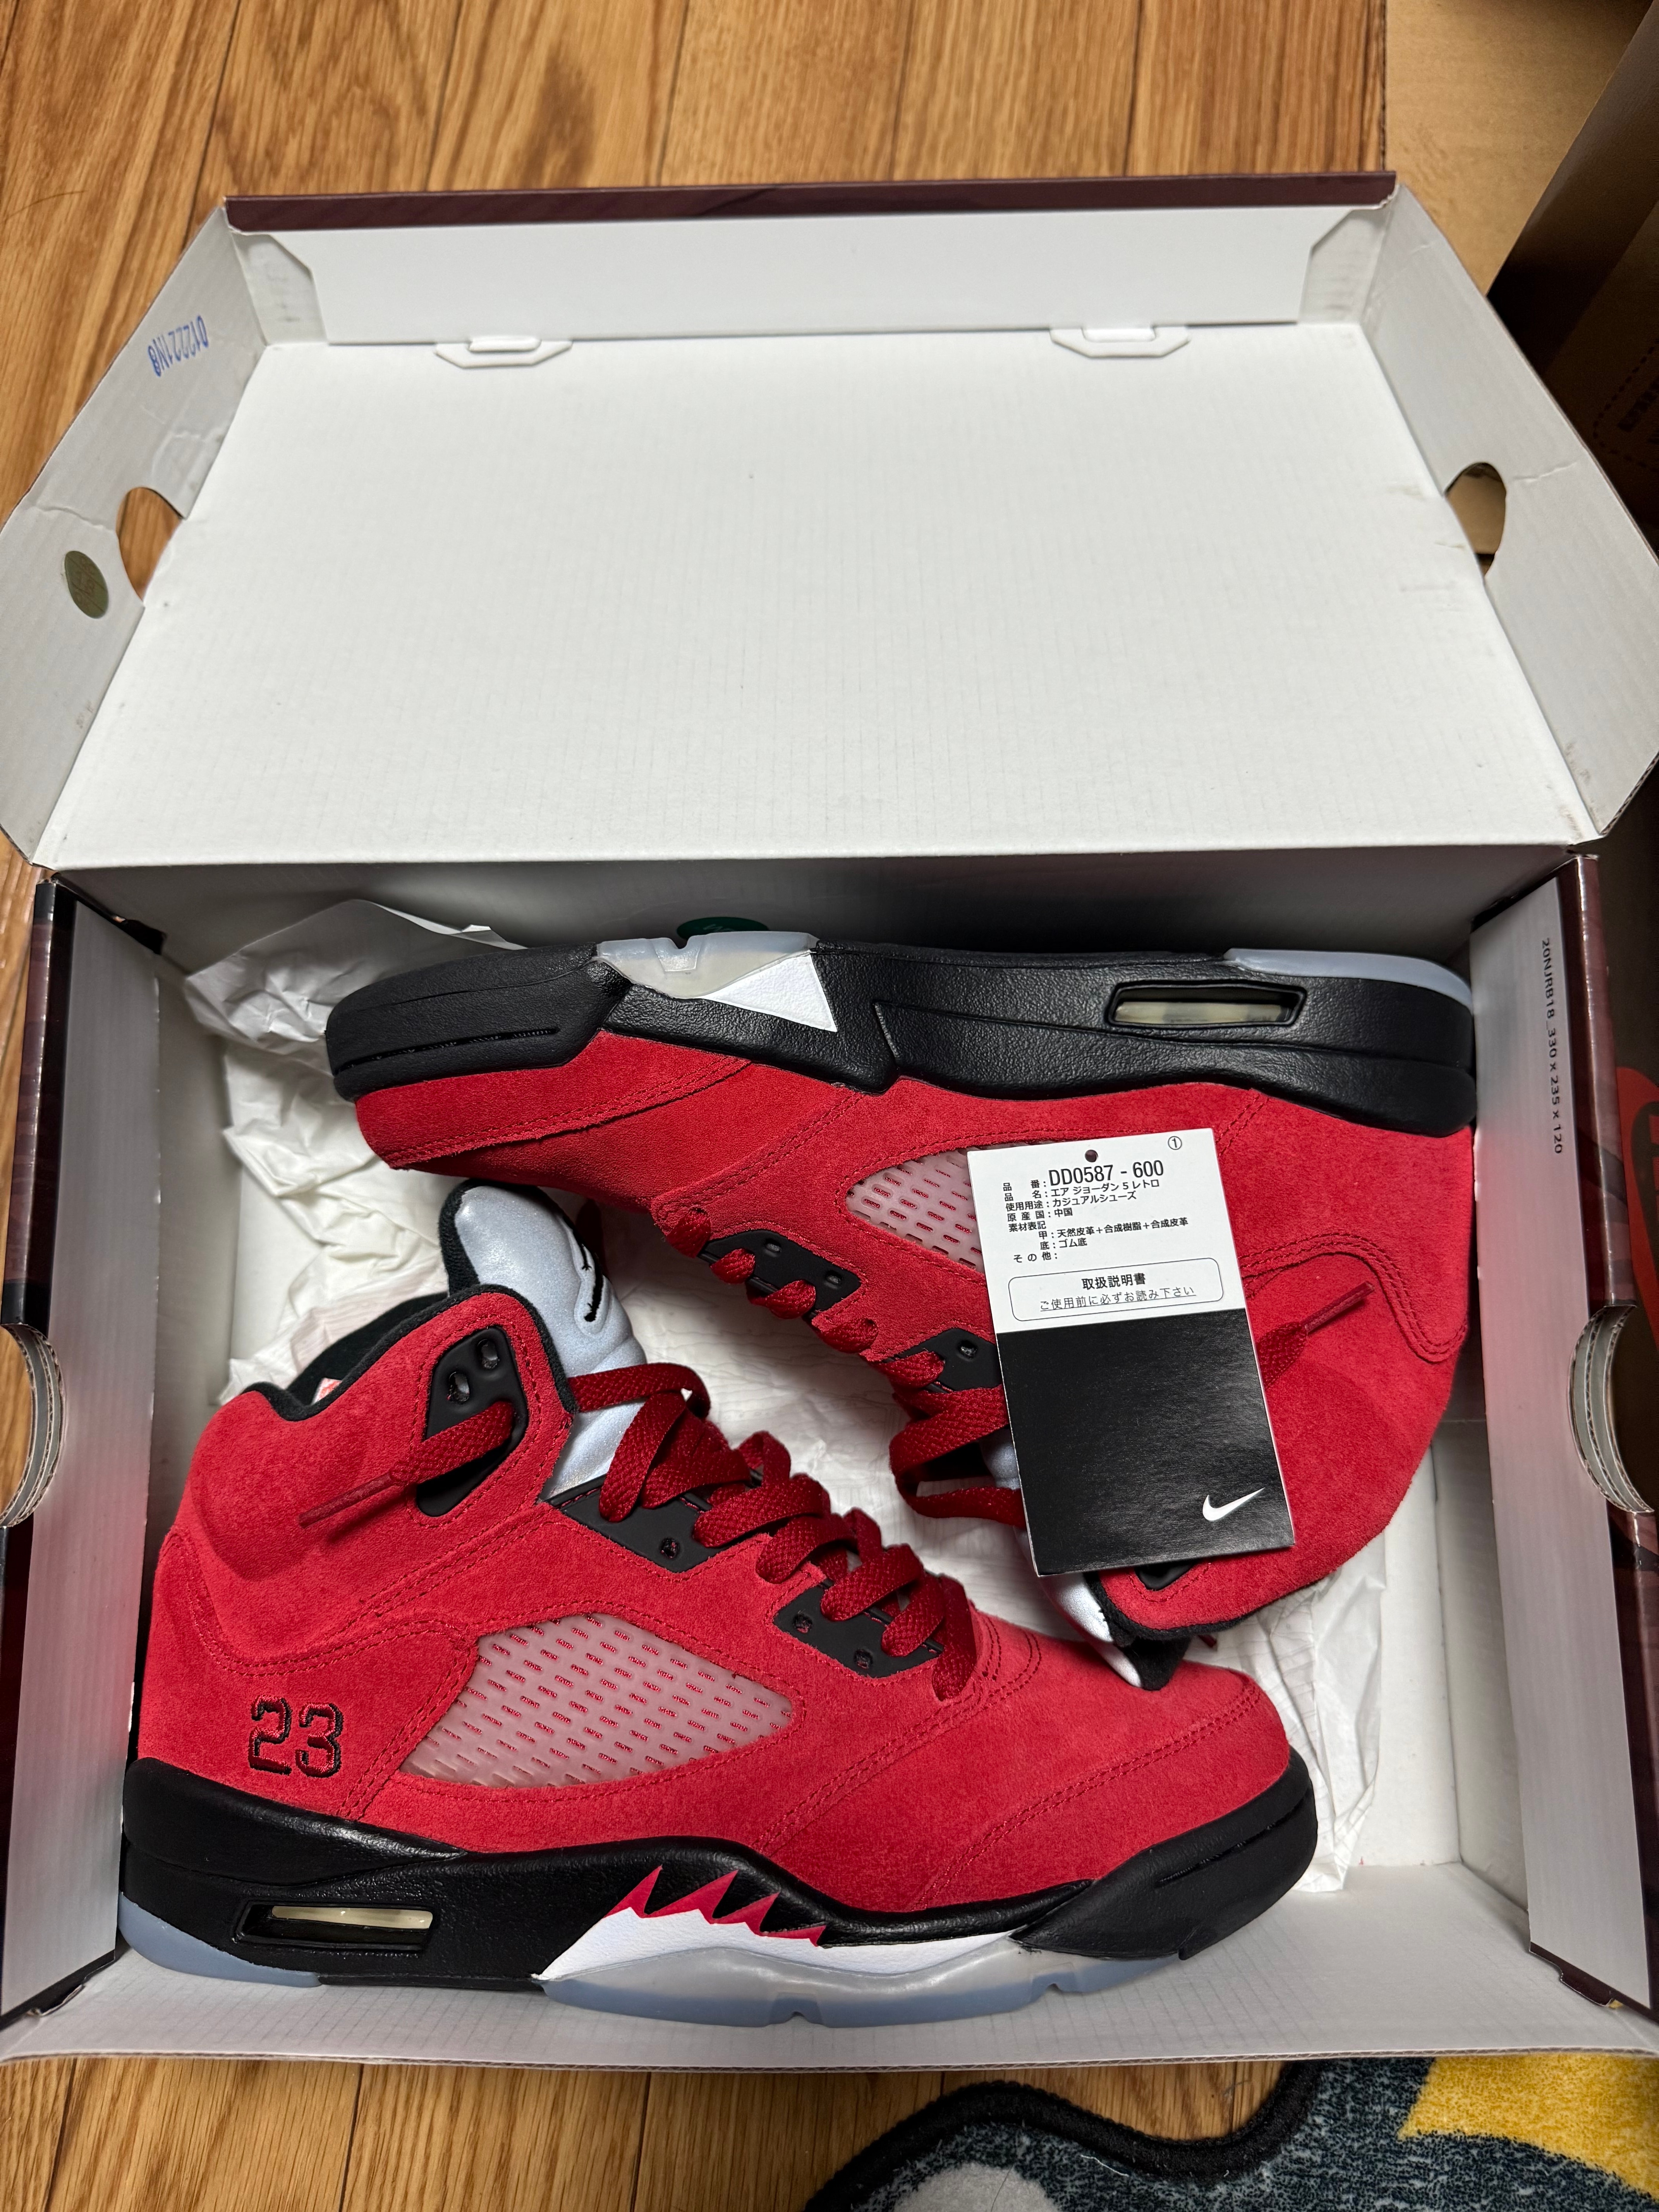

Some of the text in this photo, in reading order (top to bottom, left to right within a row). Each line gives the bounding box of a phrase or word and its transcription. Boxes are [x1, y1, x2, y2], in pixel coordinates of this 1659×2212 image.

[1551, 1075, 1559, 1105] 235
[1553, 1124, 1562, 1154] 120
[1081, 1273, 1146, 1290] 取扱説明書
[1040, 1286, 1195, 1310] ご使用前に必ずお読み下さい
[248, 1694, 344, 1778] 23
